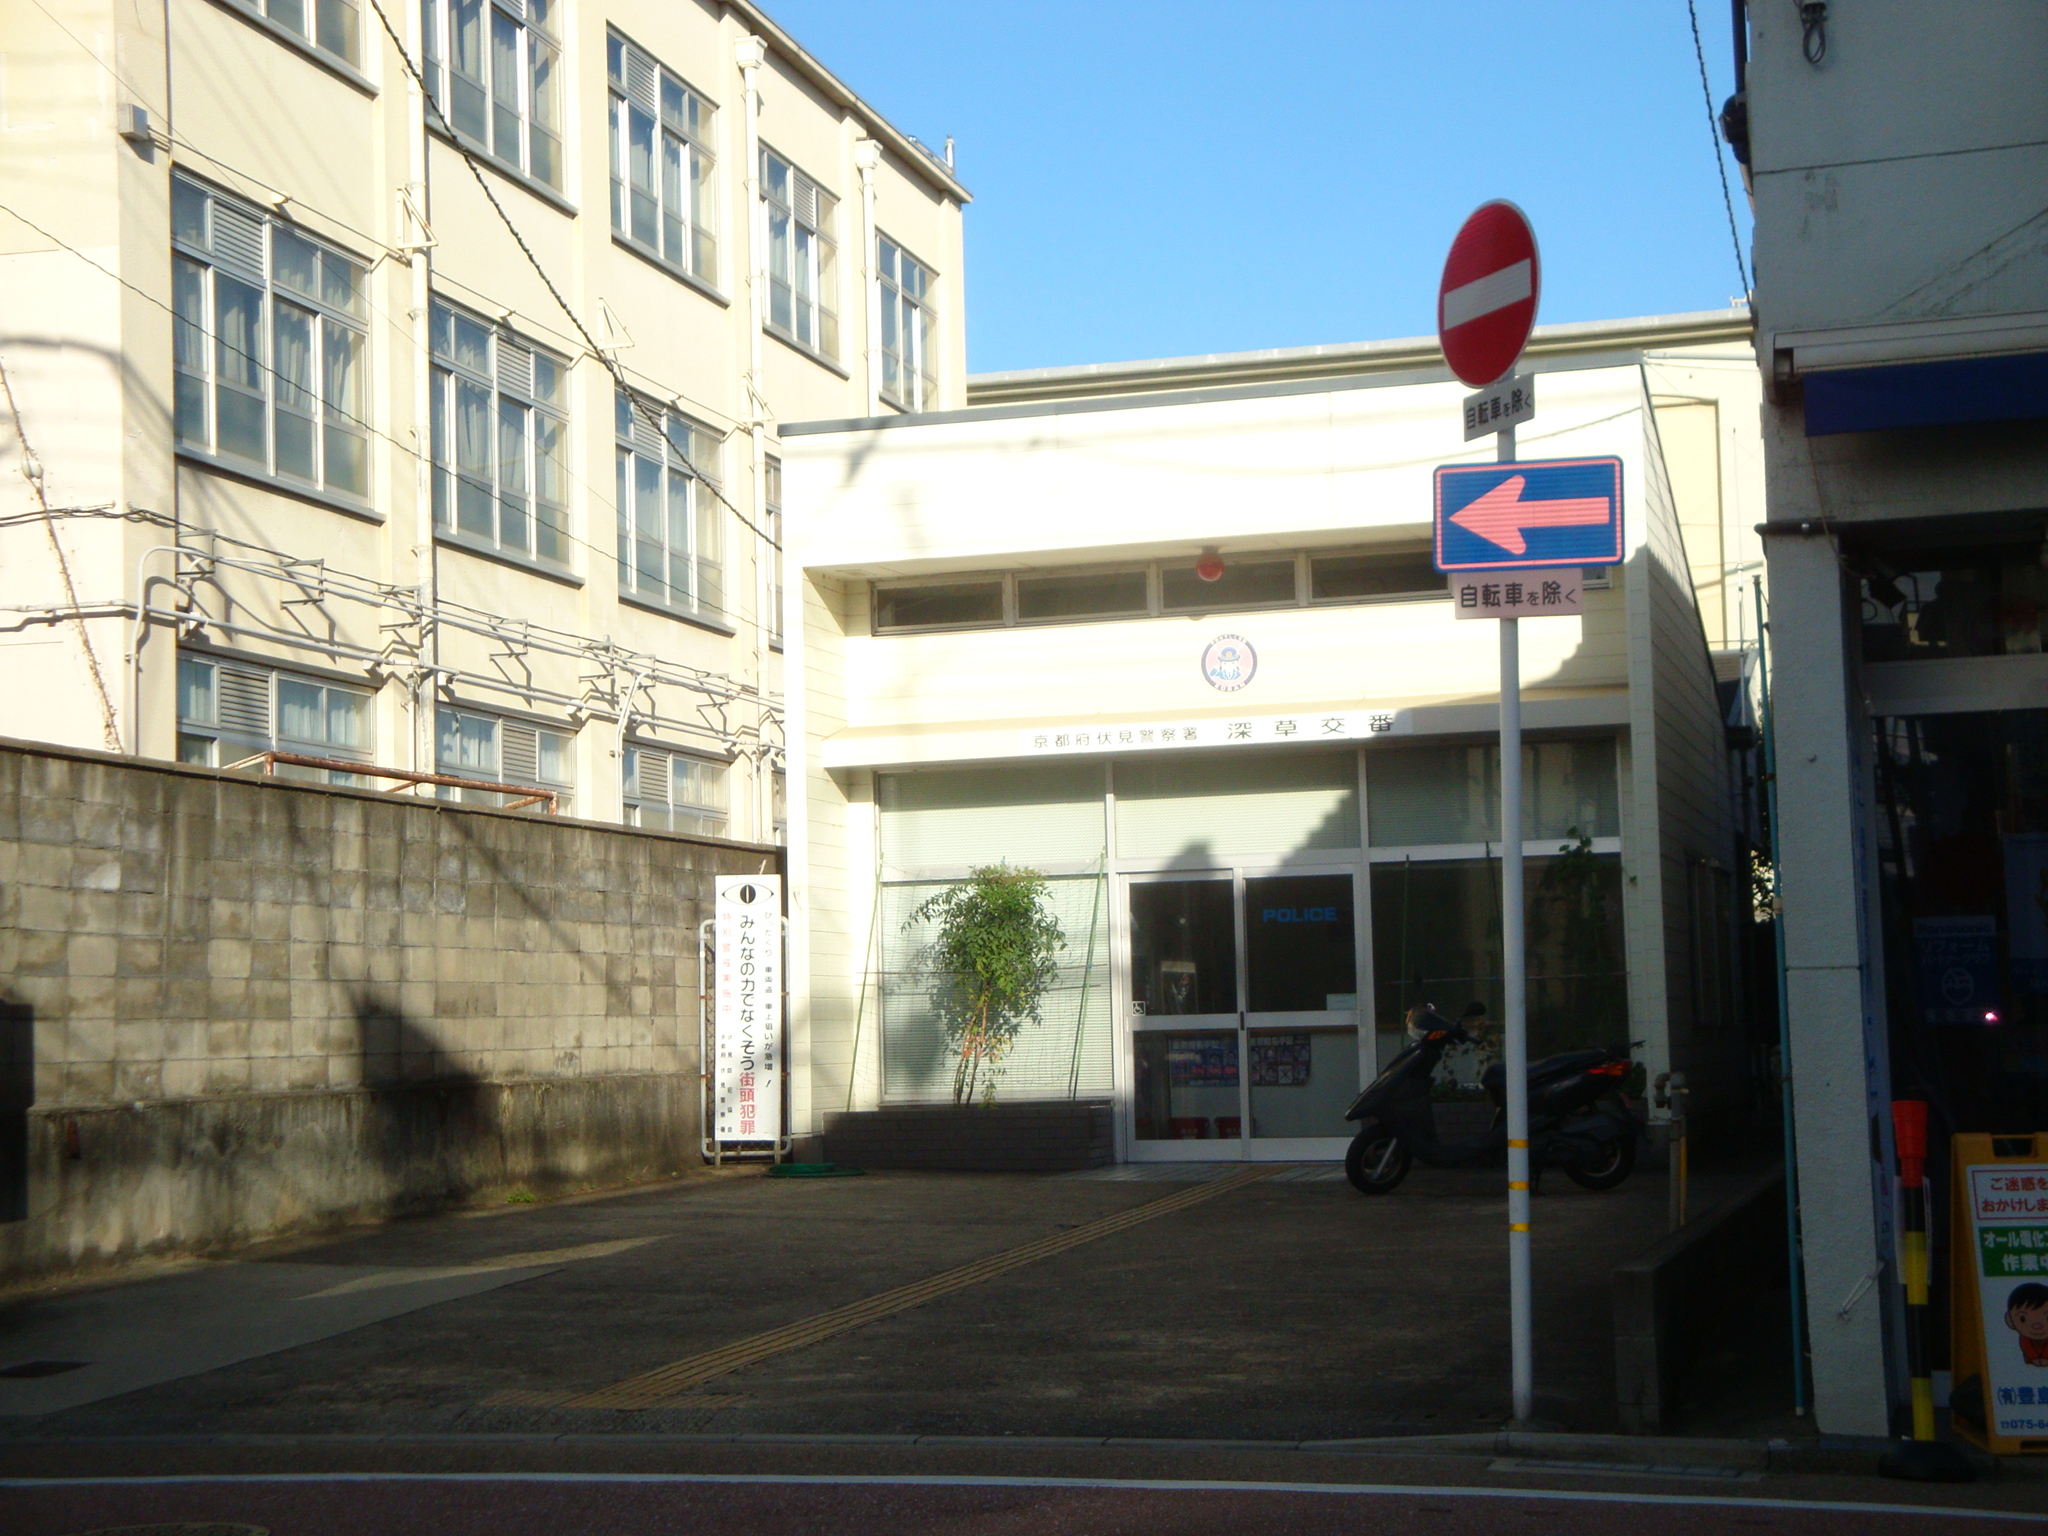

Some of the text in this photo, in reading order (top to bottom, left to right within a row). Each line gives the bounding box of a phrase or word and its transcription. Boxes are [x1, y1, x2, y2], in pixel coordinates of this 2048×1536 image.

[1466, 387, 1532, 430] 自転車を除く
[1460, 580, 1577, 608] 自転車を除く
[1033, 713, 1395, 749] 京都府伏見警察署 深草交番
[1263, 906, 1338, 923] POLICE
